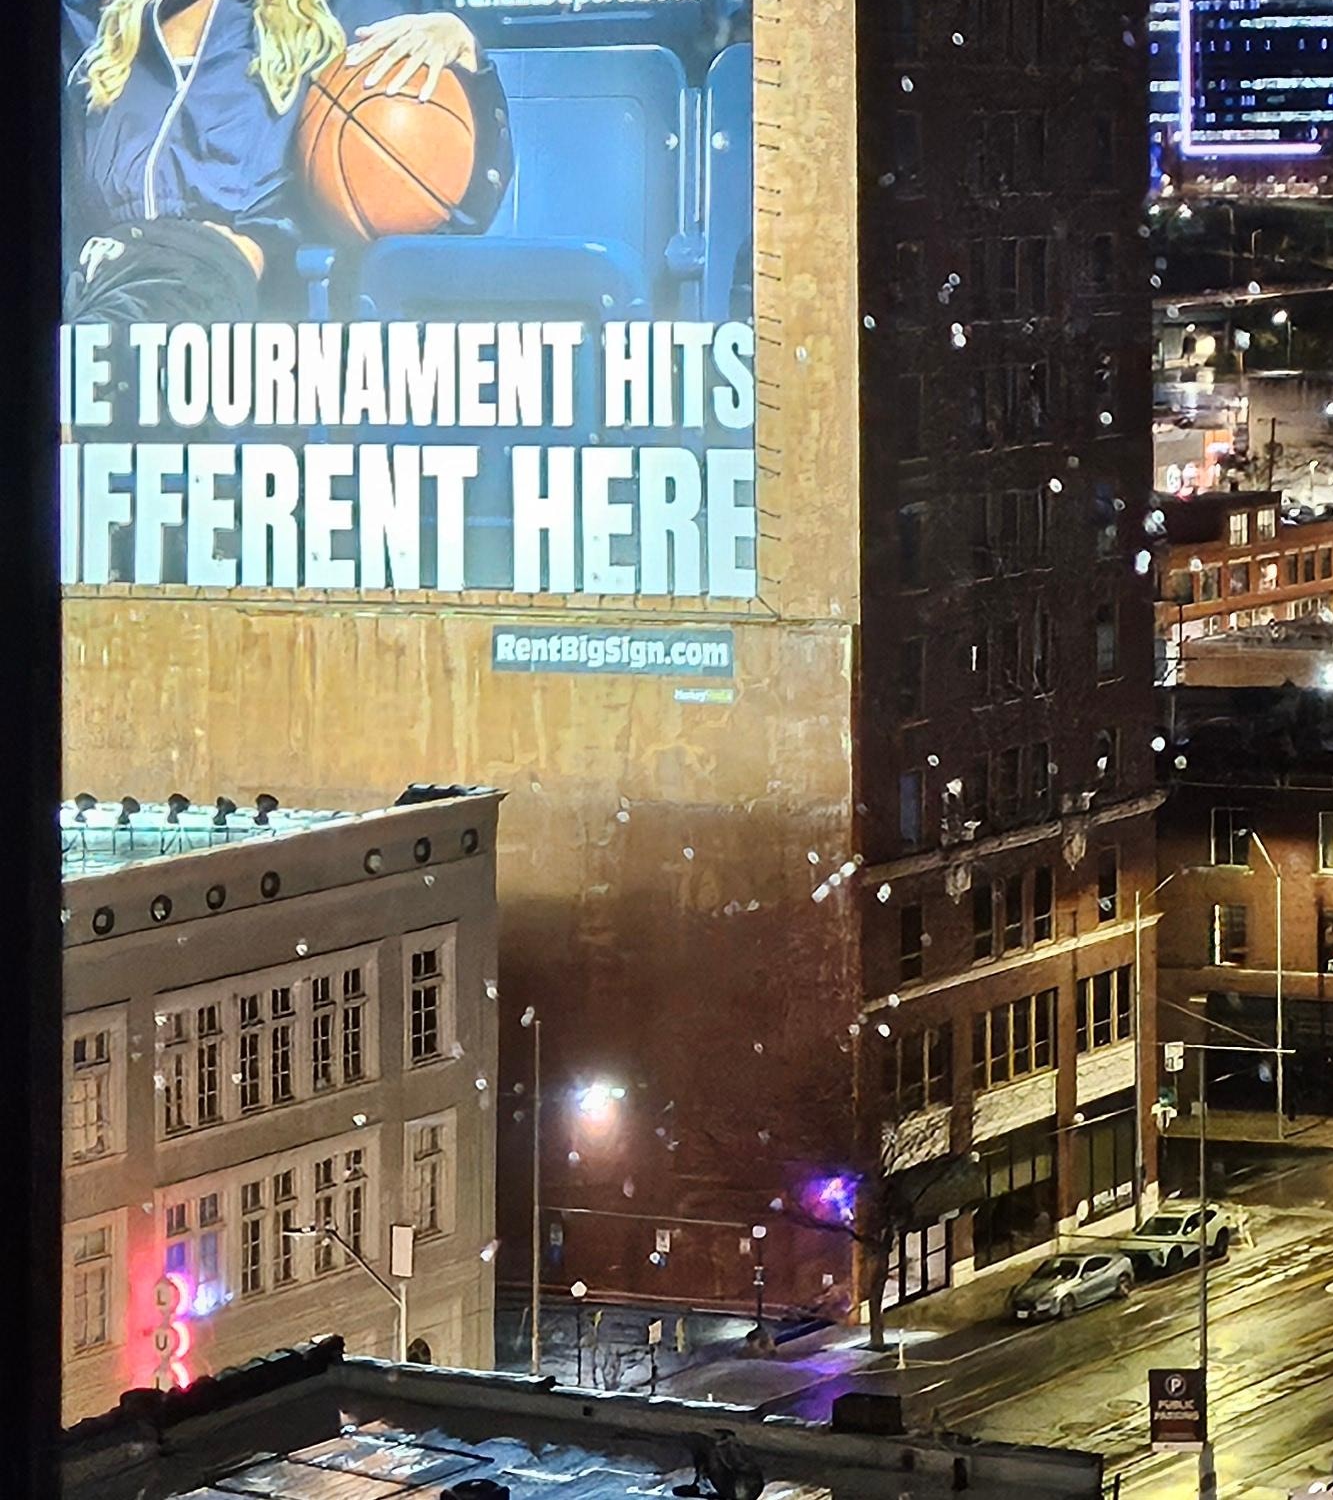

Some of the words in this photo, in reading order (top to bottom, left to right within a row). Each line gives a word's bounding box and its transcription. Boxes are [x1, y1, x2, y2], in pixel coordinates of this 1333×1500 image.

[130, 321, 583, 428] TOURNAMENT
[604, 320, 756, 430] HITS
[511, 445, 757, 598] HERE
[496, 633, 730, 669] RentBigSign.com
[1171, 1378, 1182, 1393] P
